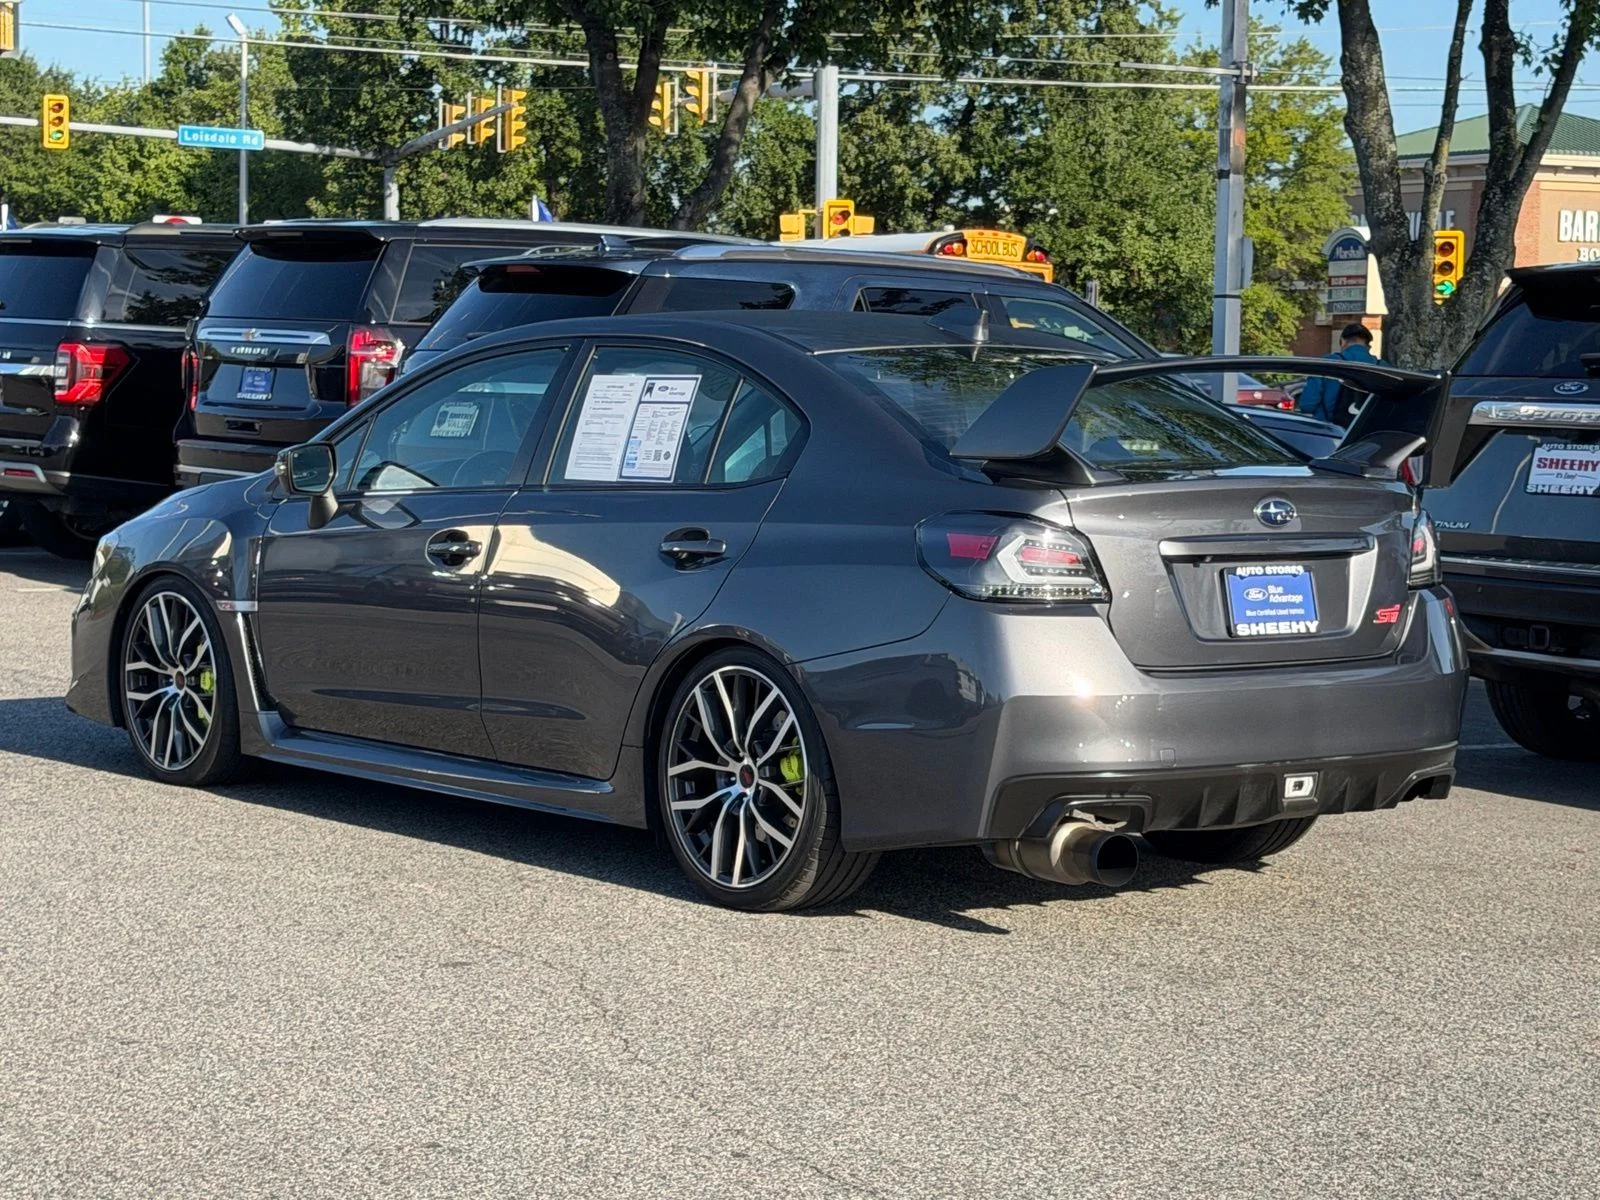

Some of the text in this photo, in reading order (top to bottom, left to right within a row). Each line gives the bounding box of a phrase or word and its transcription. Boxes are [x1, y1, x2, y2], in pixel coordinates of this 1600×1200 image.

[184, 130, 258, 145] Loisdale Rd
[1559, 210, 1600, 241] BAR
[971, 240, 1018, 257] SCHOOL BUS
[1536, 457, 1600, 472] SHEEHY
[1525, 484, 1598, 495] SHEEHY
[1236, 565, 1304, 577] AUTO STORES
[1267, 584, 1283, 594] Blue
[1269, 594, 1304, 604] Advantage
[1237, 621, 1319, 636] SHEEHY
